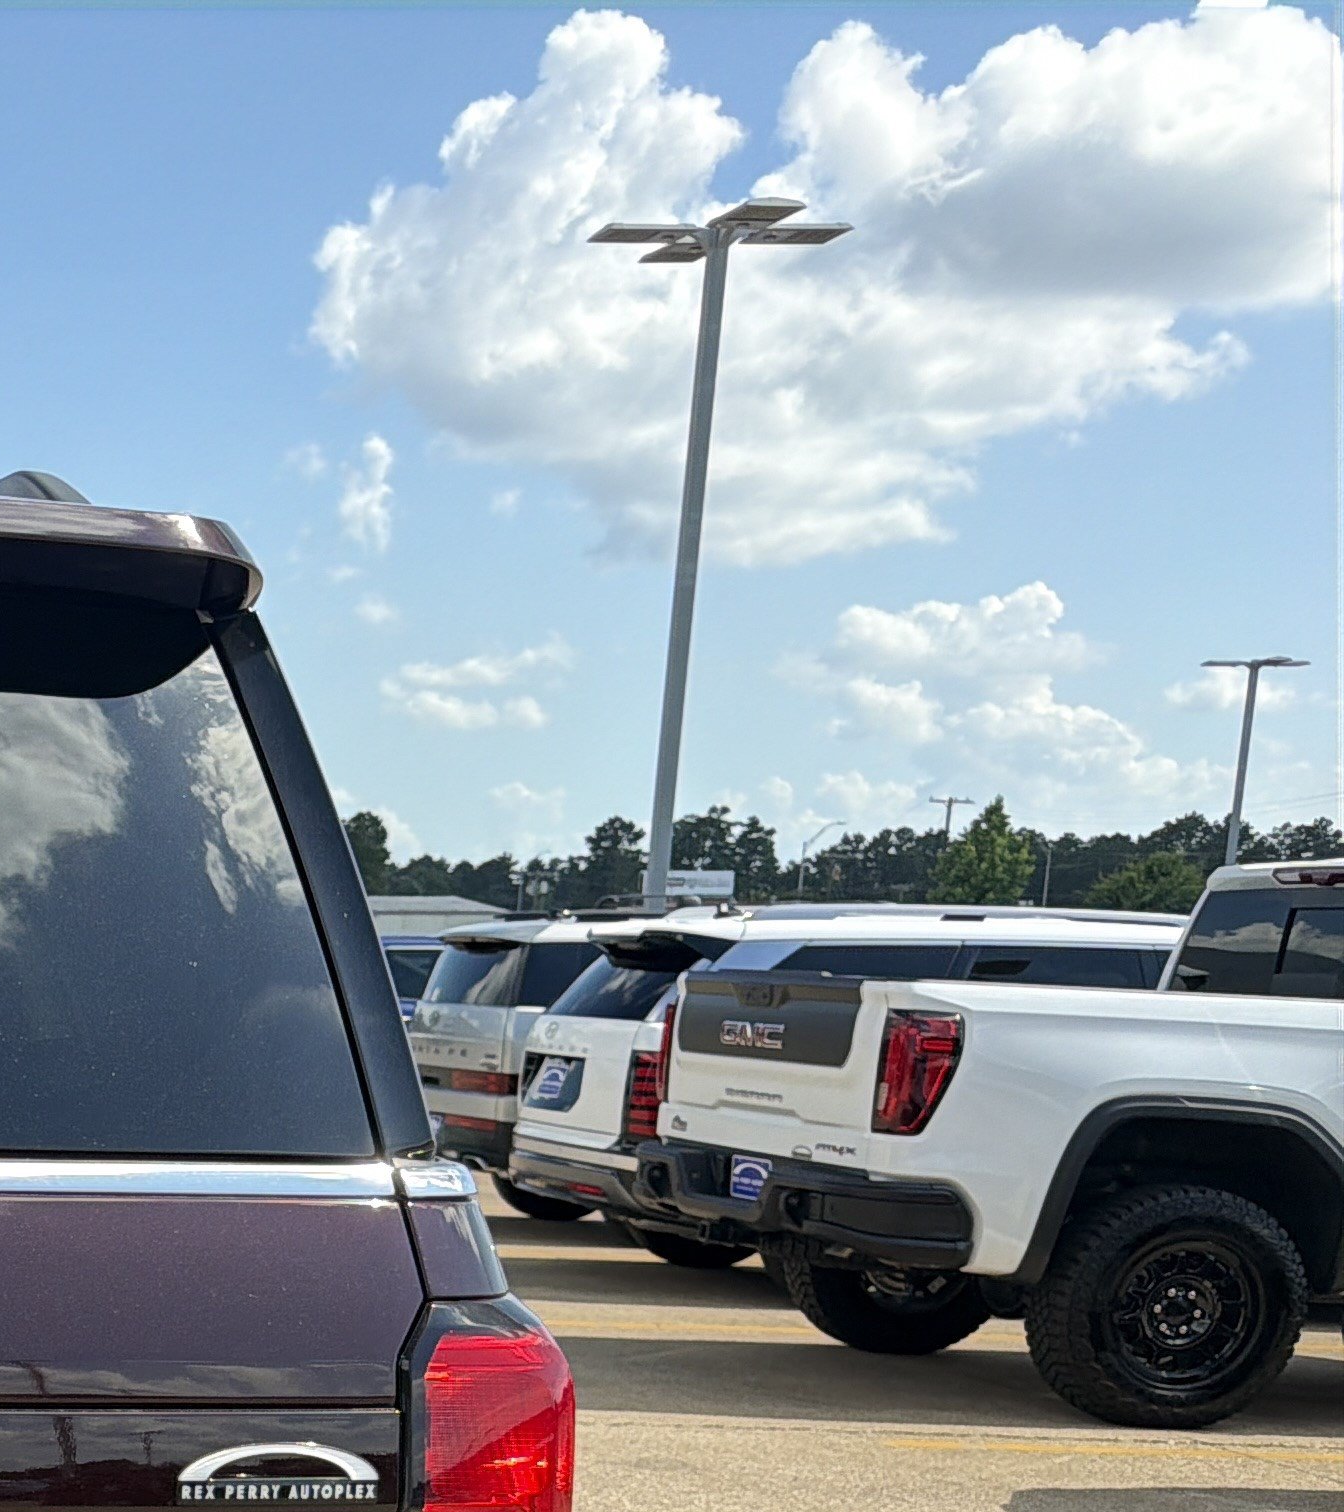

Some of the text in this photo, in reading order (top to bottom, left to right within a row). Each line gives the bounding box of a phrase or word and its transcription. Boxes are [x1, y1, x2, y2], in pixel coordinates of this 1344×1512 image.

[720, 1019, 785, 1050] GMC
[181, 1484, 376, 1500] REX PERRY AUTOPLEX
